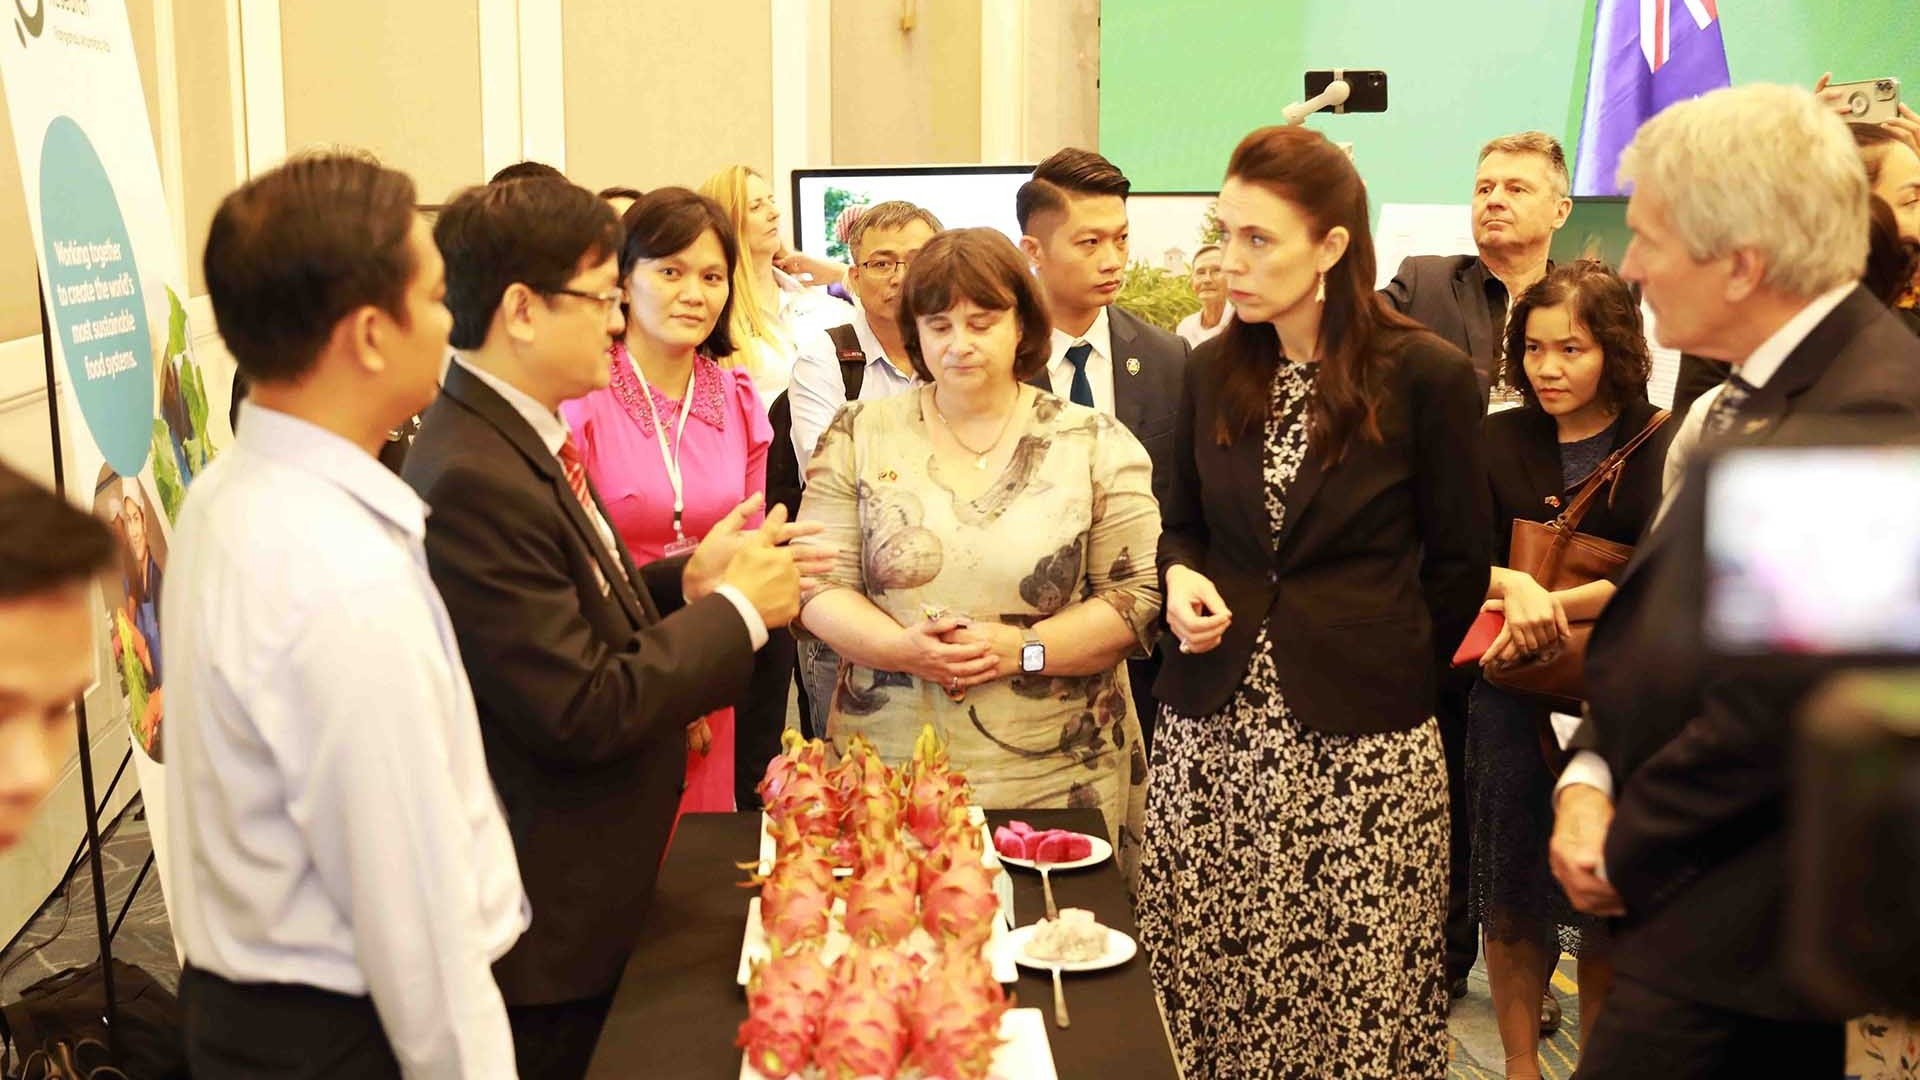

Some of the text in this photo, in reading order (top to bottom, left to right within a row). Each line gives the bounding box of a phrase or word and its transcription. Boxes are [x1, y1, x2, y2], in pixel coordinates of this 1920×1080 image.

[54, 238, 122, 270] Working together
[56, 272, 135, 306] to create the world's
[71, 309, 136, 344] most sustainable
[84, 351, 138, 381] food systems.
